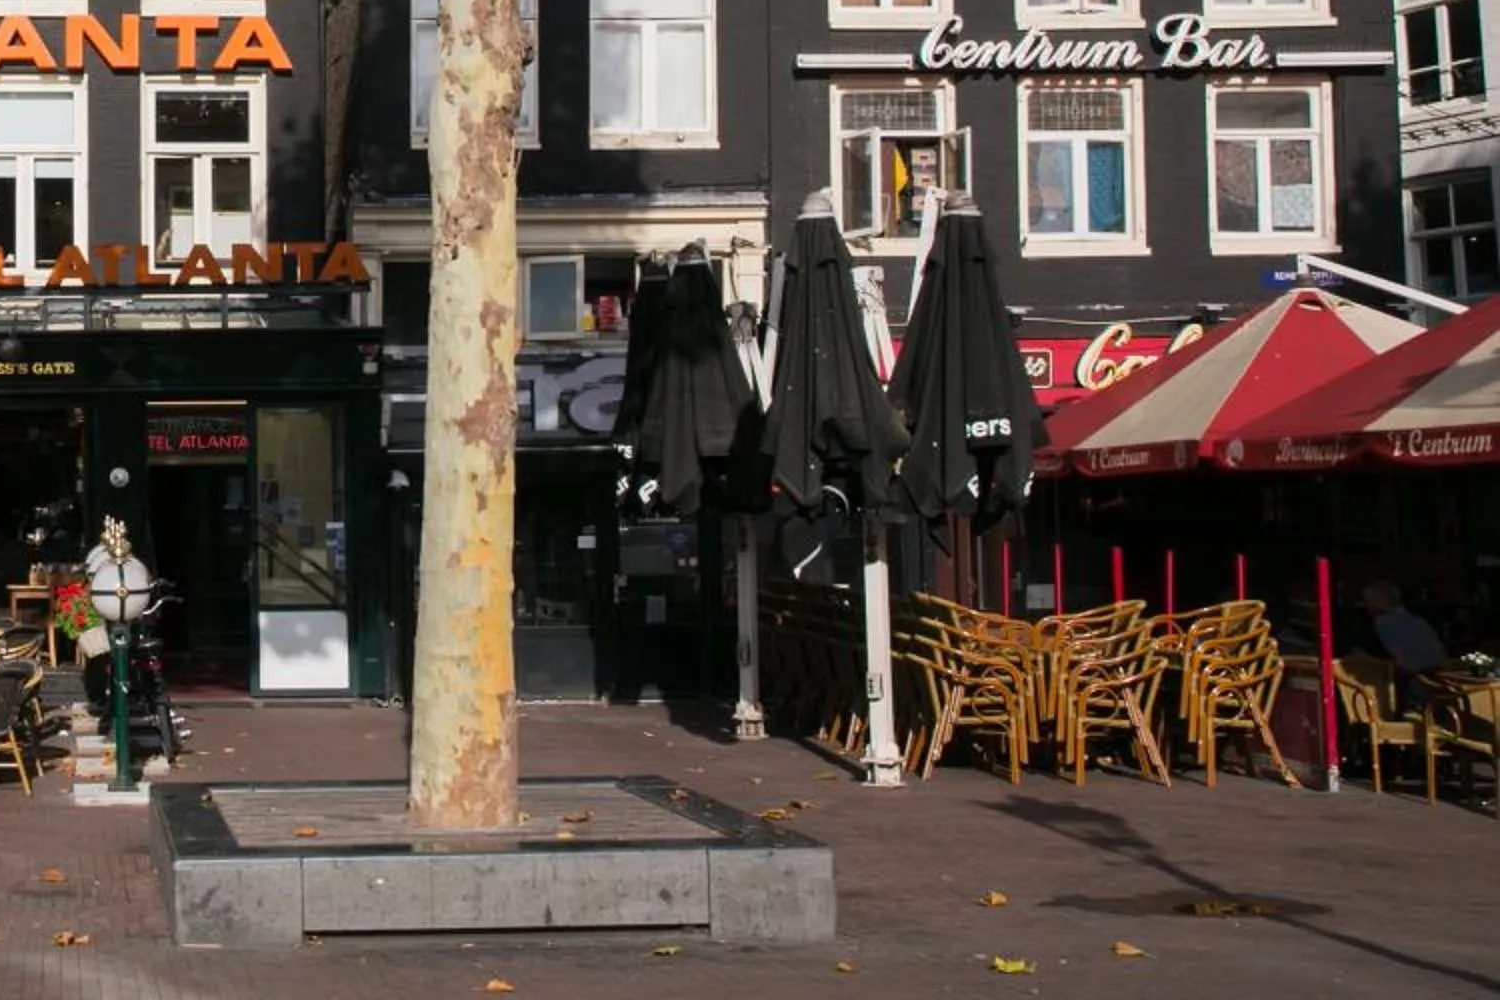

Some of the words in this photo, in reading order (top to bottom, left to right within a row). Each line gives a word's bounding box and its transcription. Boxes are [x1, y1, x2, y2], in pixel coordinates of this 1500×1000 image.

[920, 14, 1144, 69] Centrum
[1156, 13, 1271, 68] Bar
[46, 241, 370, 287] ATLANTA
[32, 361, 74, 374] GATE
[147, 434, 172, 451] TEL
[180, 434, 250, 450] ATLANTA
[1408, 428, 1493, 457] Centrum
